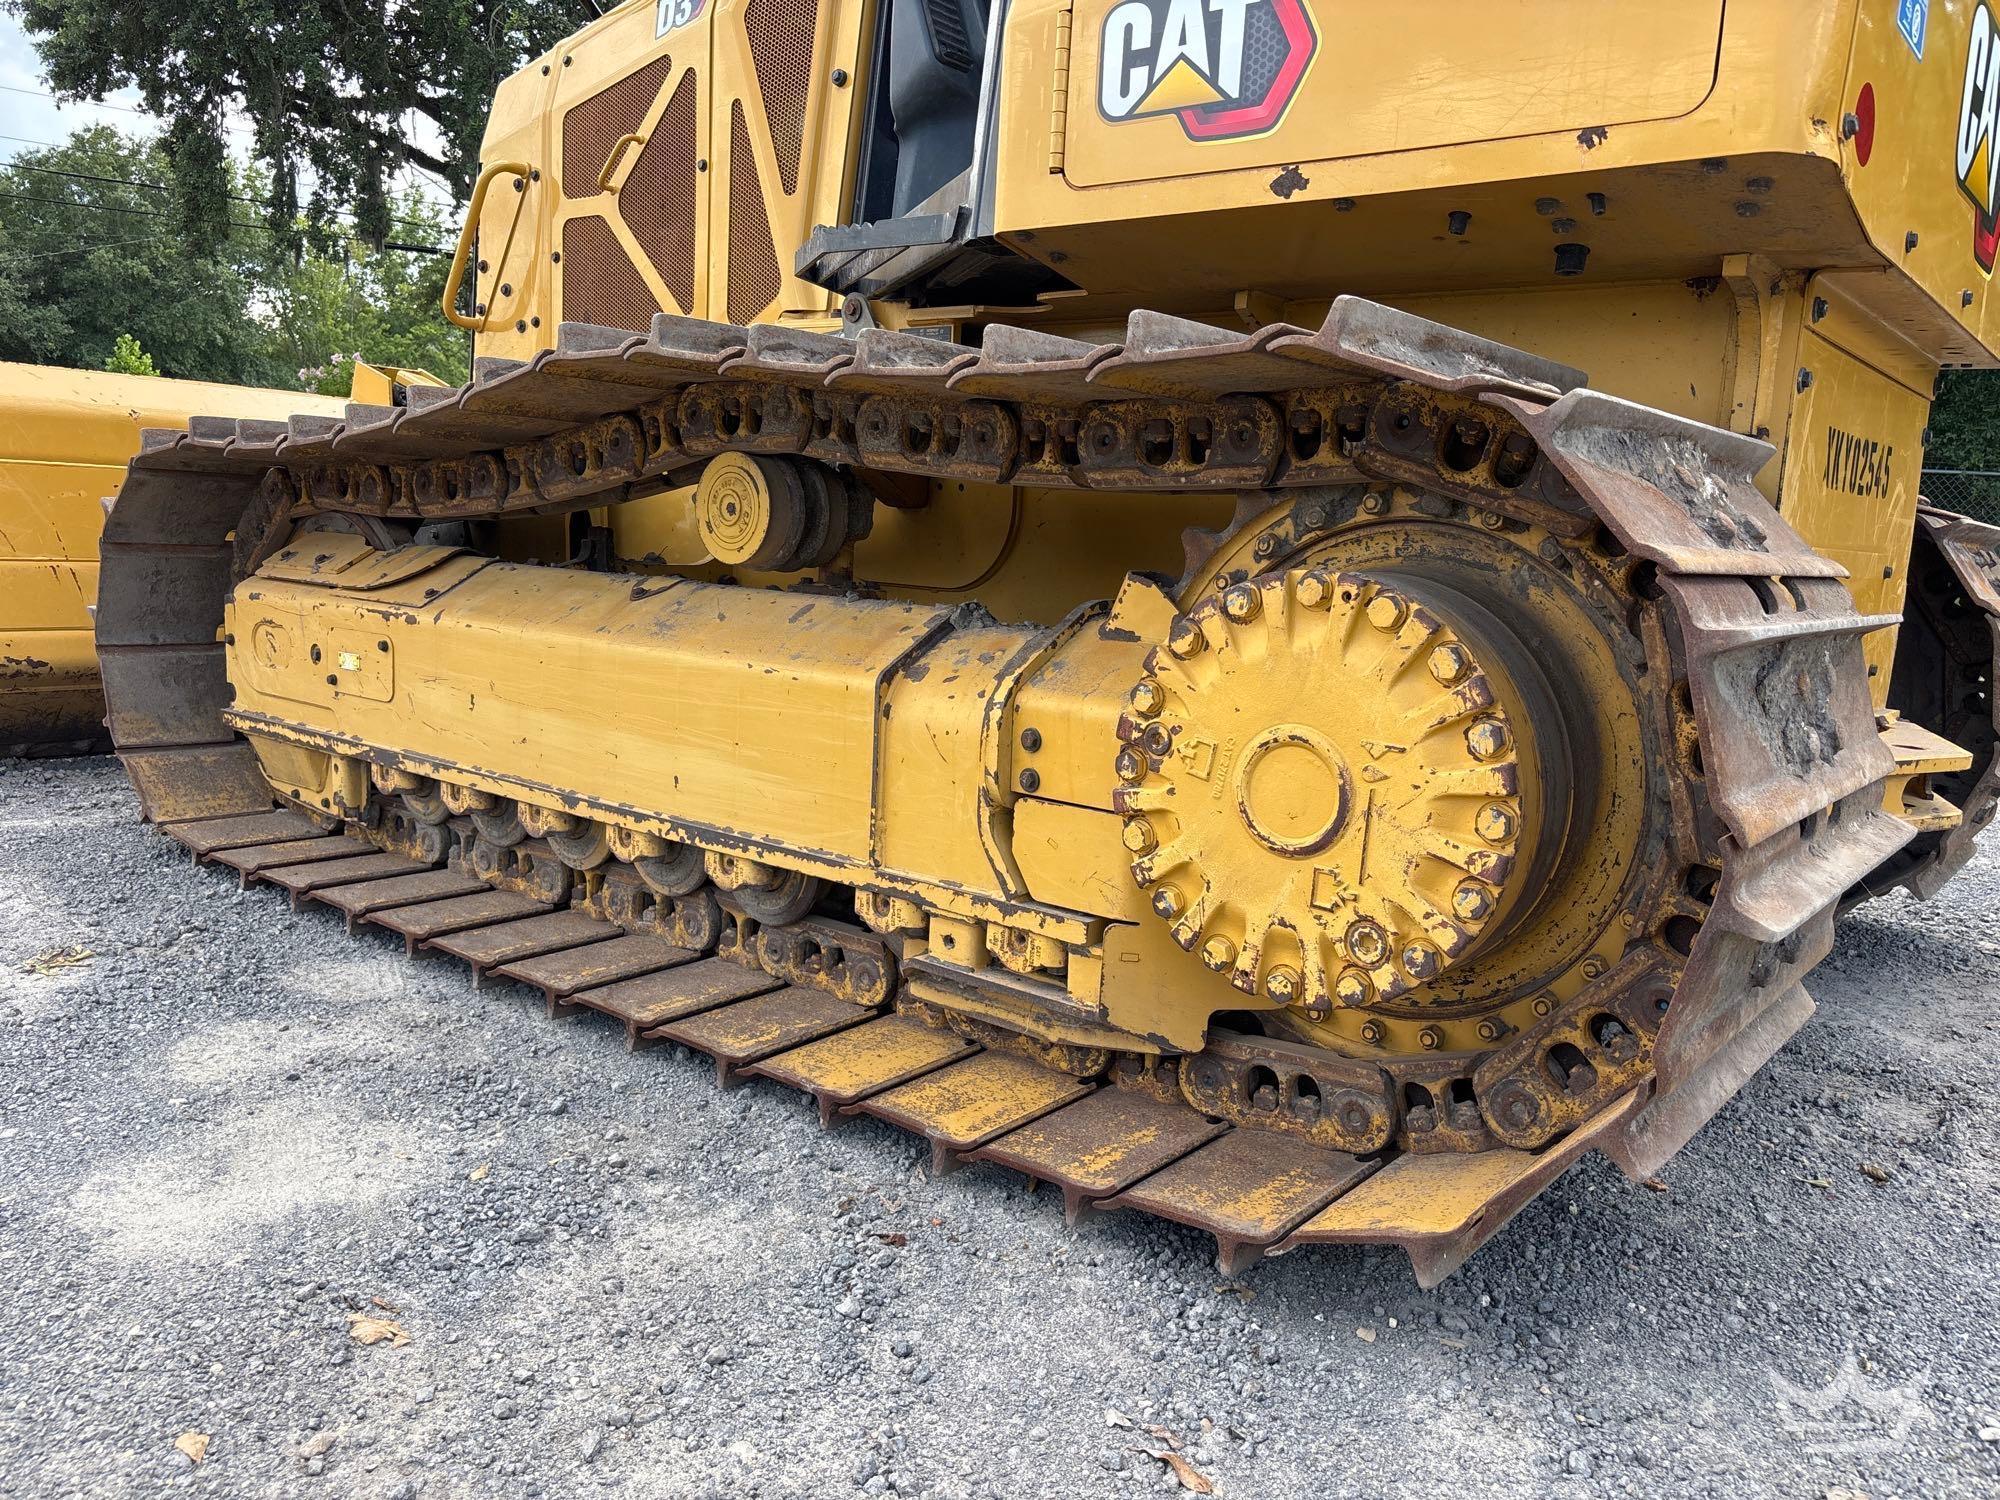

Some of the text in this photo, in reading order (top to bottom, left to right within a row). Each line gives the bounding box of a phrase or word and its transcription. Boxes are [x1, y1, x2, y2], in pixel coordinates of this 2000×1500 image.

[655, 0, 692, 39] D3
[1101, 0, 1262, 117] CAT
[1823, 426, 1893, 499] XKY02545
